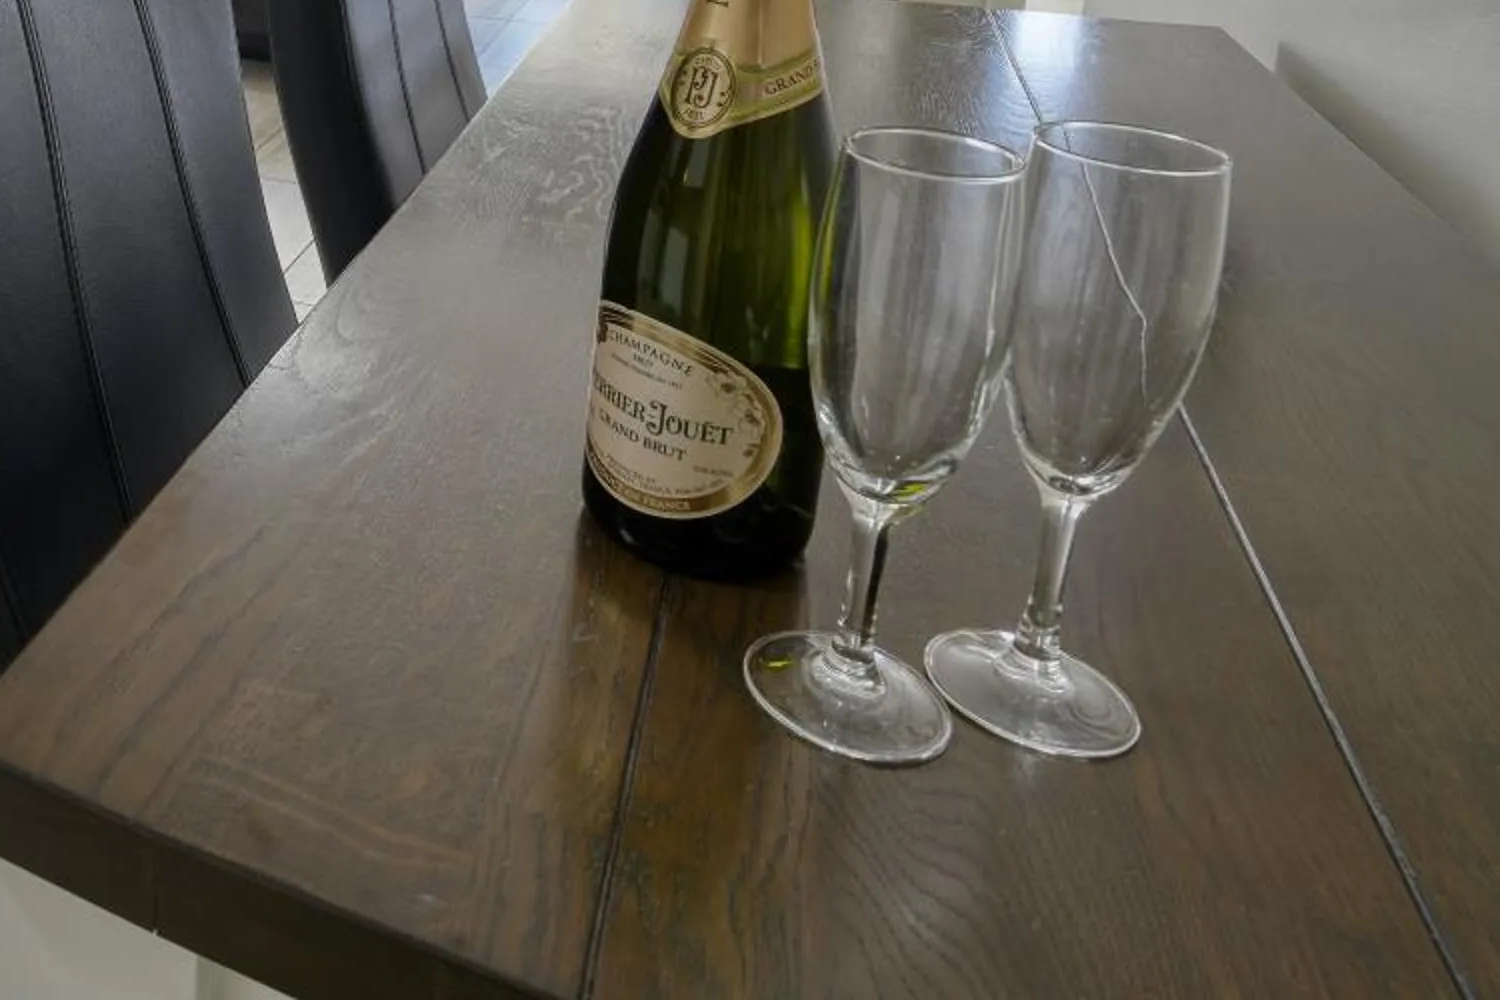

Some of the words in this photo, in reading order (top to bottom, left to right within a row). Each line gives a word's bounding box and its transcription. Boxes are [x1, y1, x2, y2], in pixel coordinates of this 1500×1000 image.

[764, 65, 814, 96] GRAND
[606, 329, 693, 375] CHAMPAGNE
[599, 408, 639, 443] GRAND
[643, 437, 688, 462] BRUT
